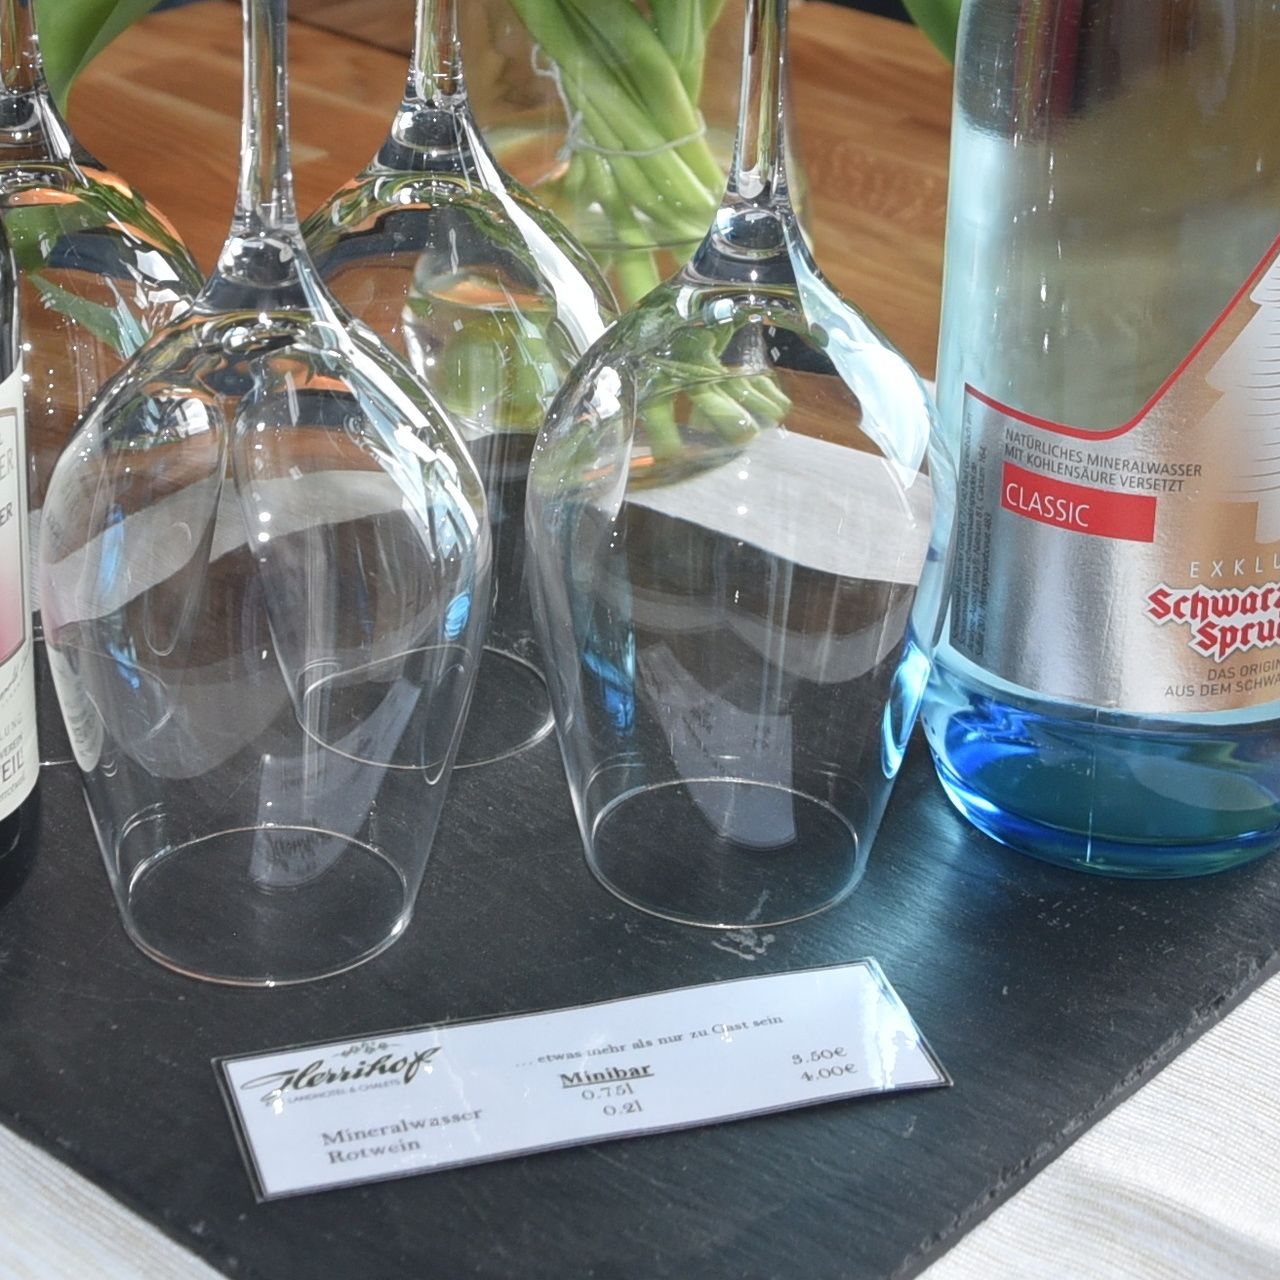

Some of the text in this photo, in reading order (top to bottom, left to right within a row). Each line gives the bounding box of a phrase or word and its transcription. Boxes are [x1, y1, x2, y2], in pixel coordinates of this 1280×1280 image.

[1004, 444, 1185, 493] MIT KOHLENSÄURE VERSETZT
[1005, 427, 1202, 477] NATÜRLICHES MINERALWASSER
[1005, 482, 1090, 527] CLASSIC
[1164, 684, 1195, 697] AUS
[1200, 681, 1231, 697] DEM
[1207, 668, 1235, 682] DAS
[537, 1051, 582, 1064] etwas
[632, 1037, 653, 1050] als
[658, 1033, 684, 1045] nur
[689, 1028, 709, 1039] zu
[753, 1015, 784, 1028] sein
[240, 1046, 442, 1103] Herrihof
[560, 1064, 655, 1089] Minibar
[321, 1108, 483, 1146] Mineralwasser
[328, 1138, 422, 1164] Rotwein
